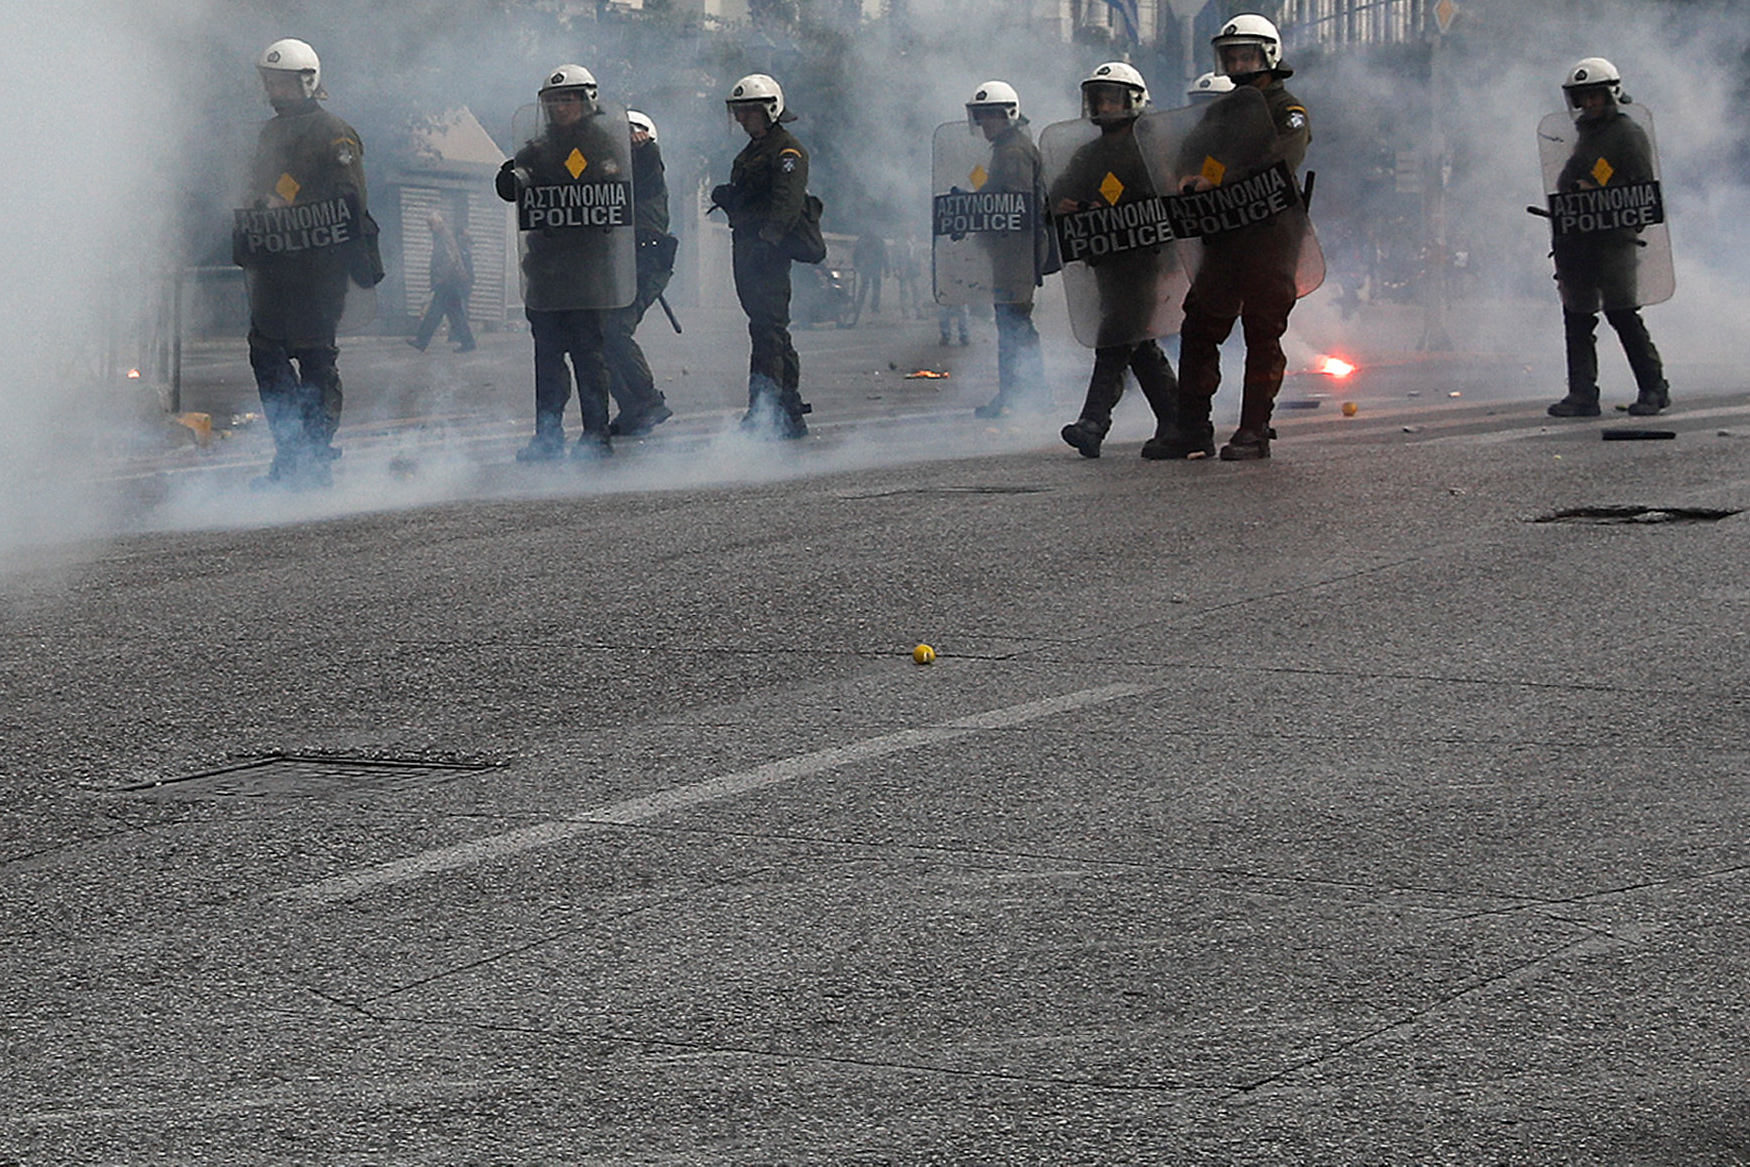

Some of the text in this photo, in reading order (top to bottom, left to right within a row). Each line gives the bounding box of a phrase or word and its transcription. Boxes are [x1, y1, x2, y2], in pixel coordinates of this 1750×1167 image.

[523, 183, 627, 210] ΑΣΤΥΝΟΜΙΑ
[937, 193, 1026, 218] ΑΣΤΥΝΟΜΙΑ
[1169, 167, 1287, 219] ΑΣΤΥΝΟΜΙΑ
[1554, 184, 1657, 216] ΑΣΤΥΝΟΜΙΑ
[530, 205, 623, 228] POLICE
[941, 213, 1022, 232] POLICE
[1180, 190, 1288, 237] POLICE
[1561, 206, 1655, 234] POLICE
[249, 222, 350, 253] POLICE
[1070, 221, 1174, 258] POLICE
